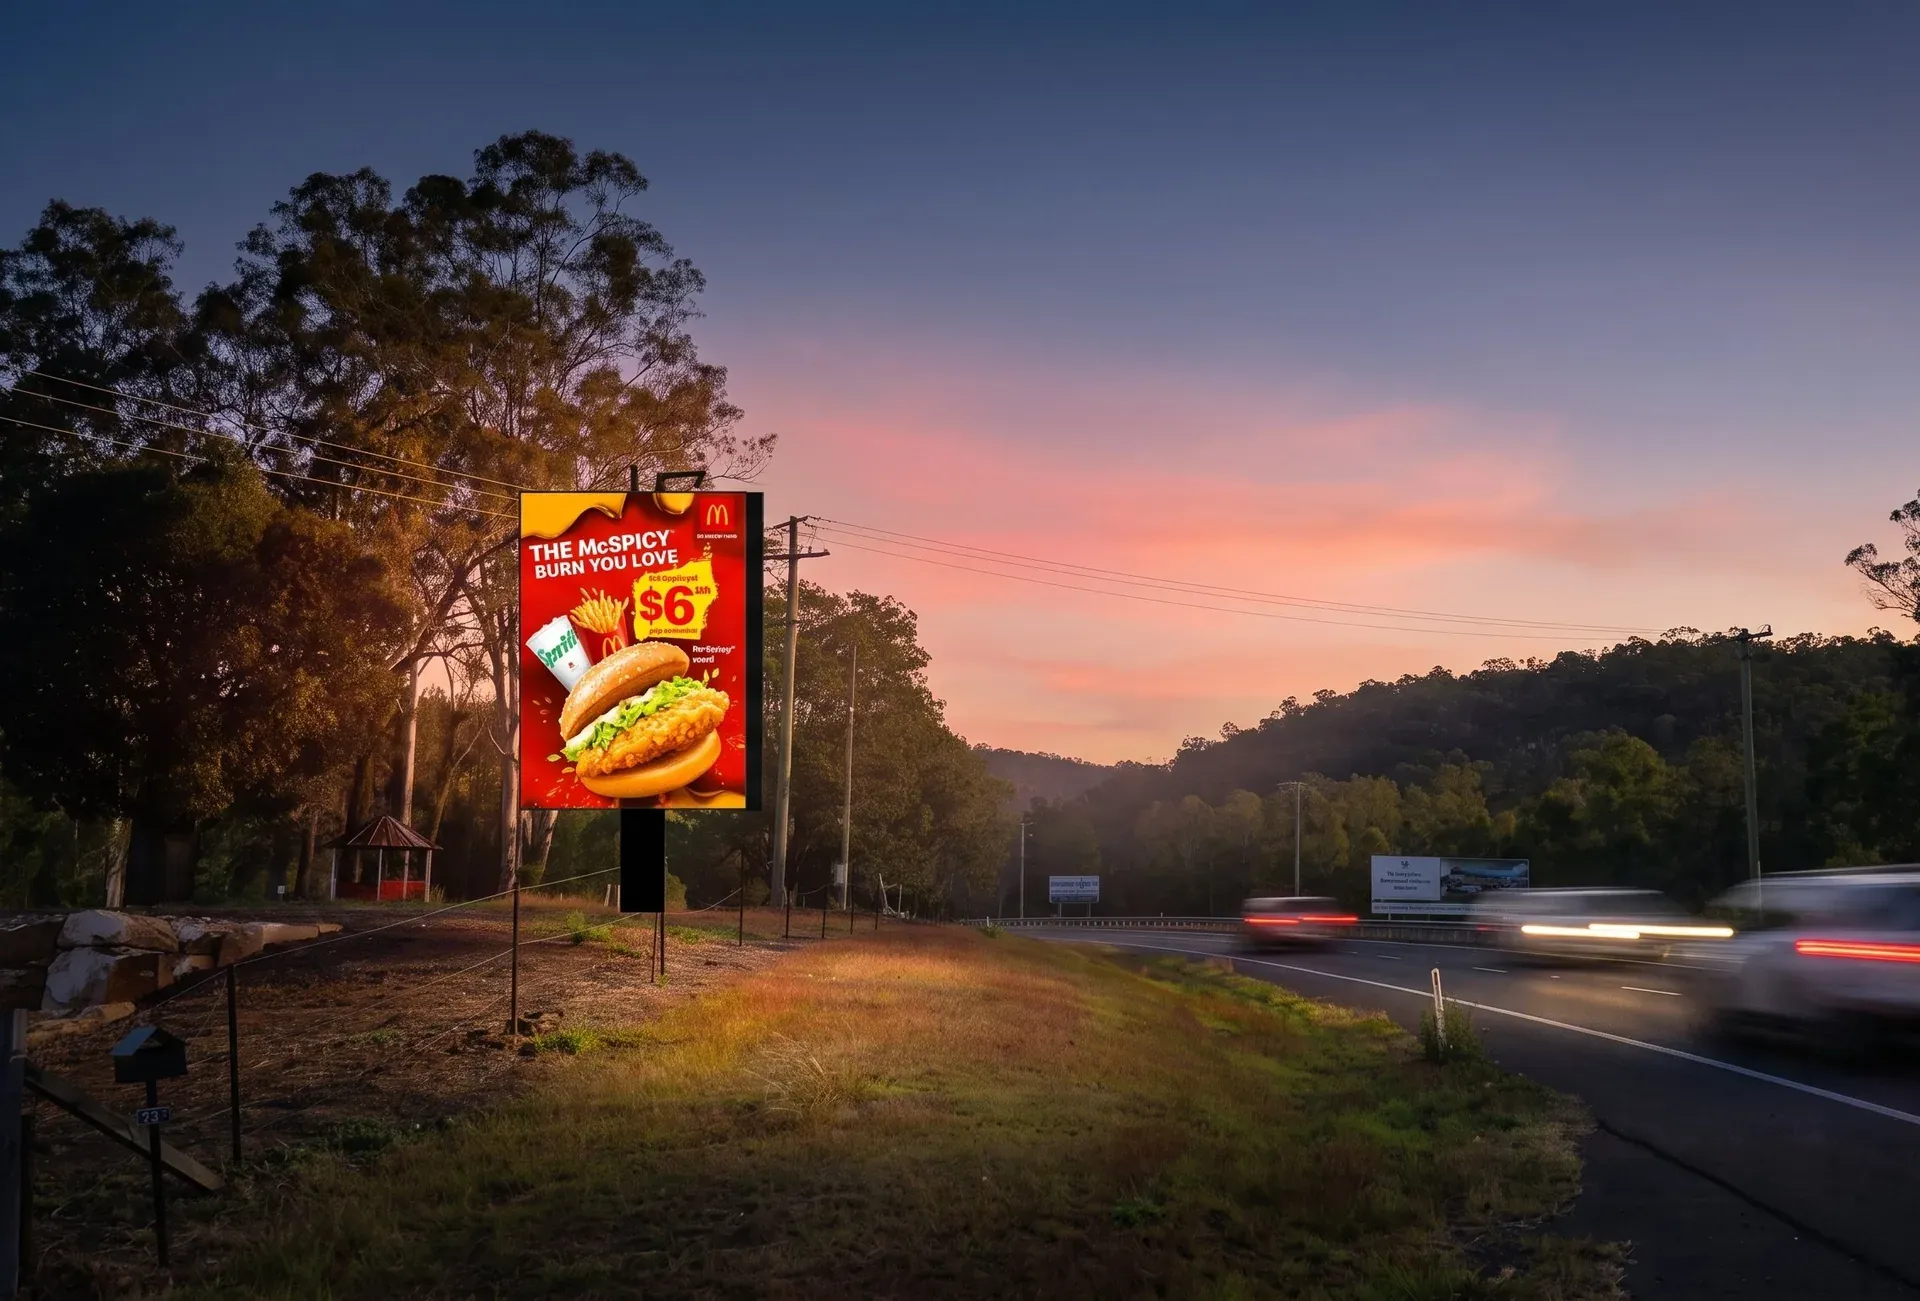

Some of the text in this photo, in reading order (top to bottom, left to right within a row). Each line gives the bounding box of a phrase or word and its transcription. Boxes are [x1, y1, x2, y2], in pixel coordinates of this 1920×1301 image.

[529, 541, 573, 562] THE
[535, 549, 678, 579] BURN YOU LOVE
[640, 585, 695, 626] $6
[142, 1110, 159, 1122] 23
